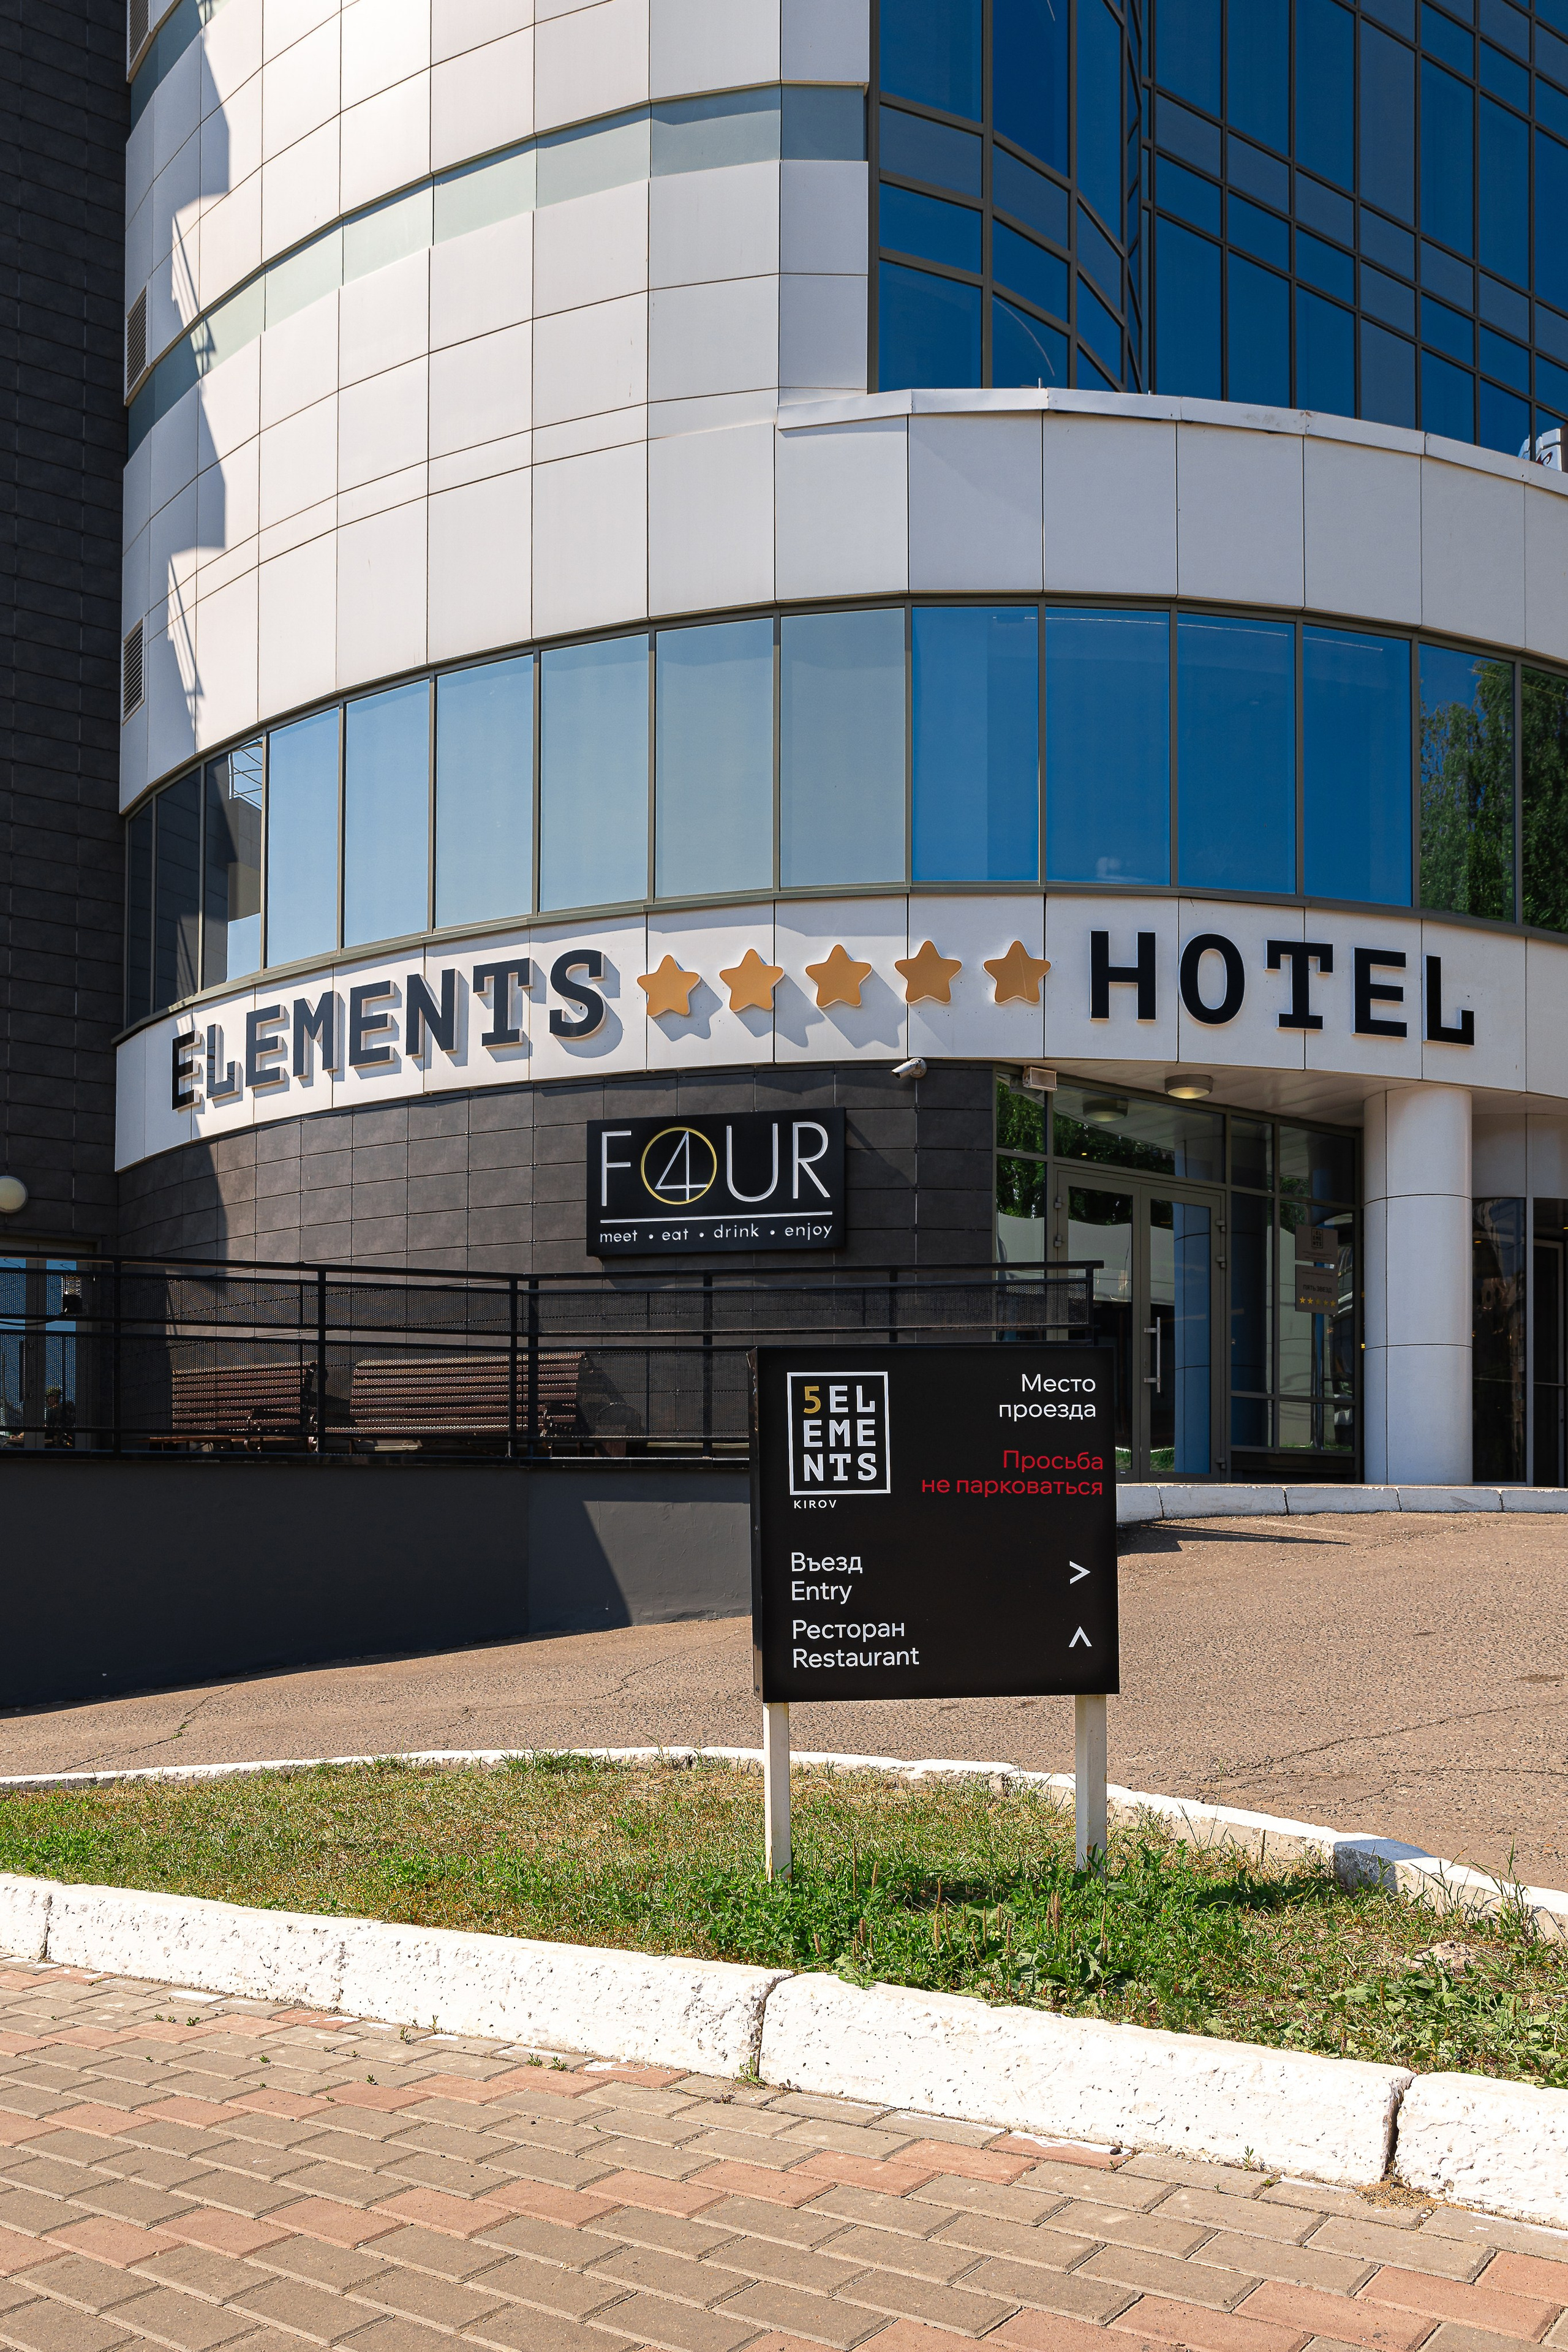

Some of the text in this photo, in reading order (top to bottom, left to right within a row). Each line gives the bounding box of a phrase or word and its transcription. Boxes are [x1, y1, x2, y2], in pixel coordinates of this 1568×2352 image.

[172, 930, 1475, 1111] ELEMENTS HOTEL
[600, 1223, 832, 1242] meet eat drink enjoy
[1022, 1374, 1096, 1393] Место
[998, 1402, 1096, 1422] проезда
[804, 1420, 876, 1448] EME
[804, 1453, 877, 1482] NTS
[1003, 1450, 1104, 1473] Просьба
[922, 1479, 1103, 1497] не парковаться
[794, 1499, 837, 1509] KIROV
[791, 1552, 863, 1575] Въезд
[791, 1581, 853, 1605] Entry
[793, 1619, 905, 1642] Ресторан
[793, 1647, 920, 1668] Restaurant
